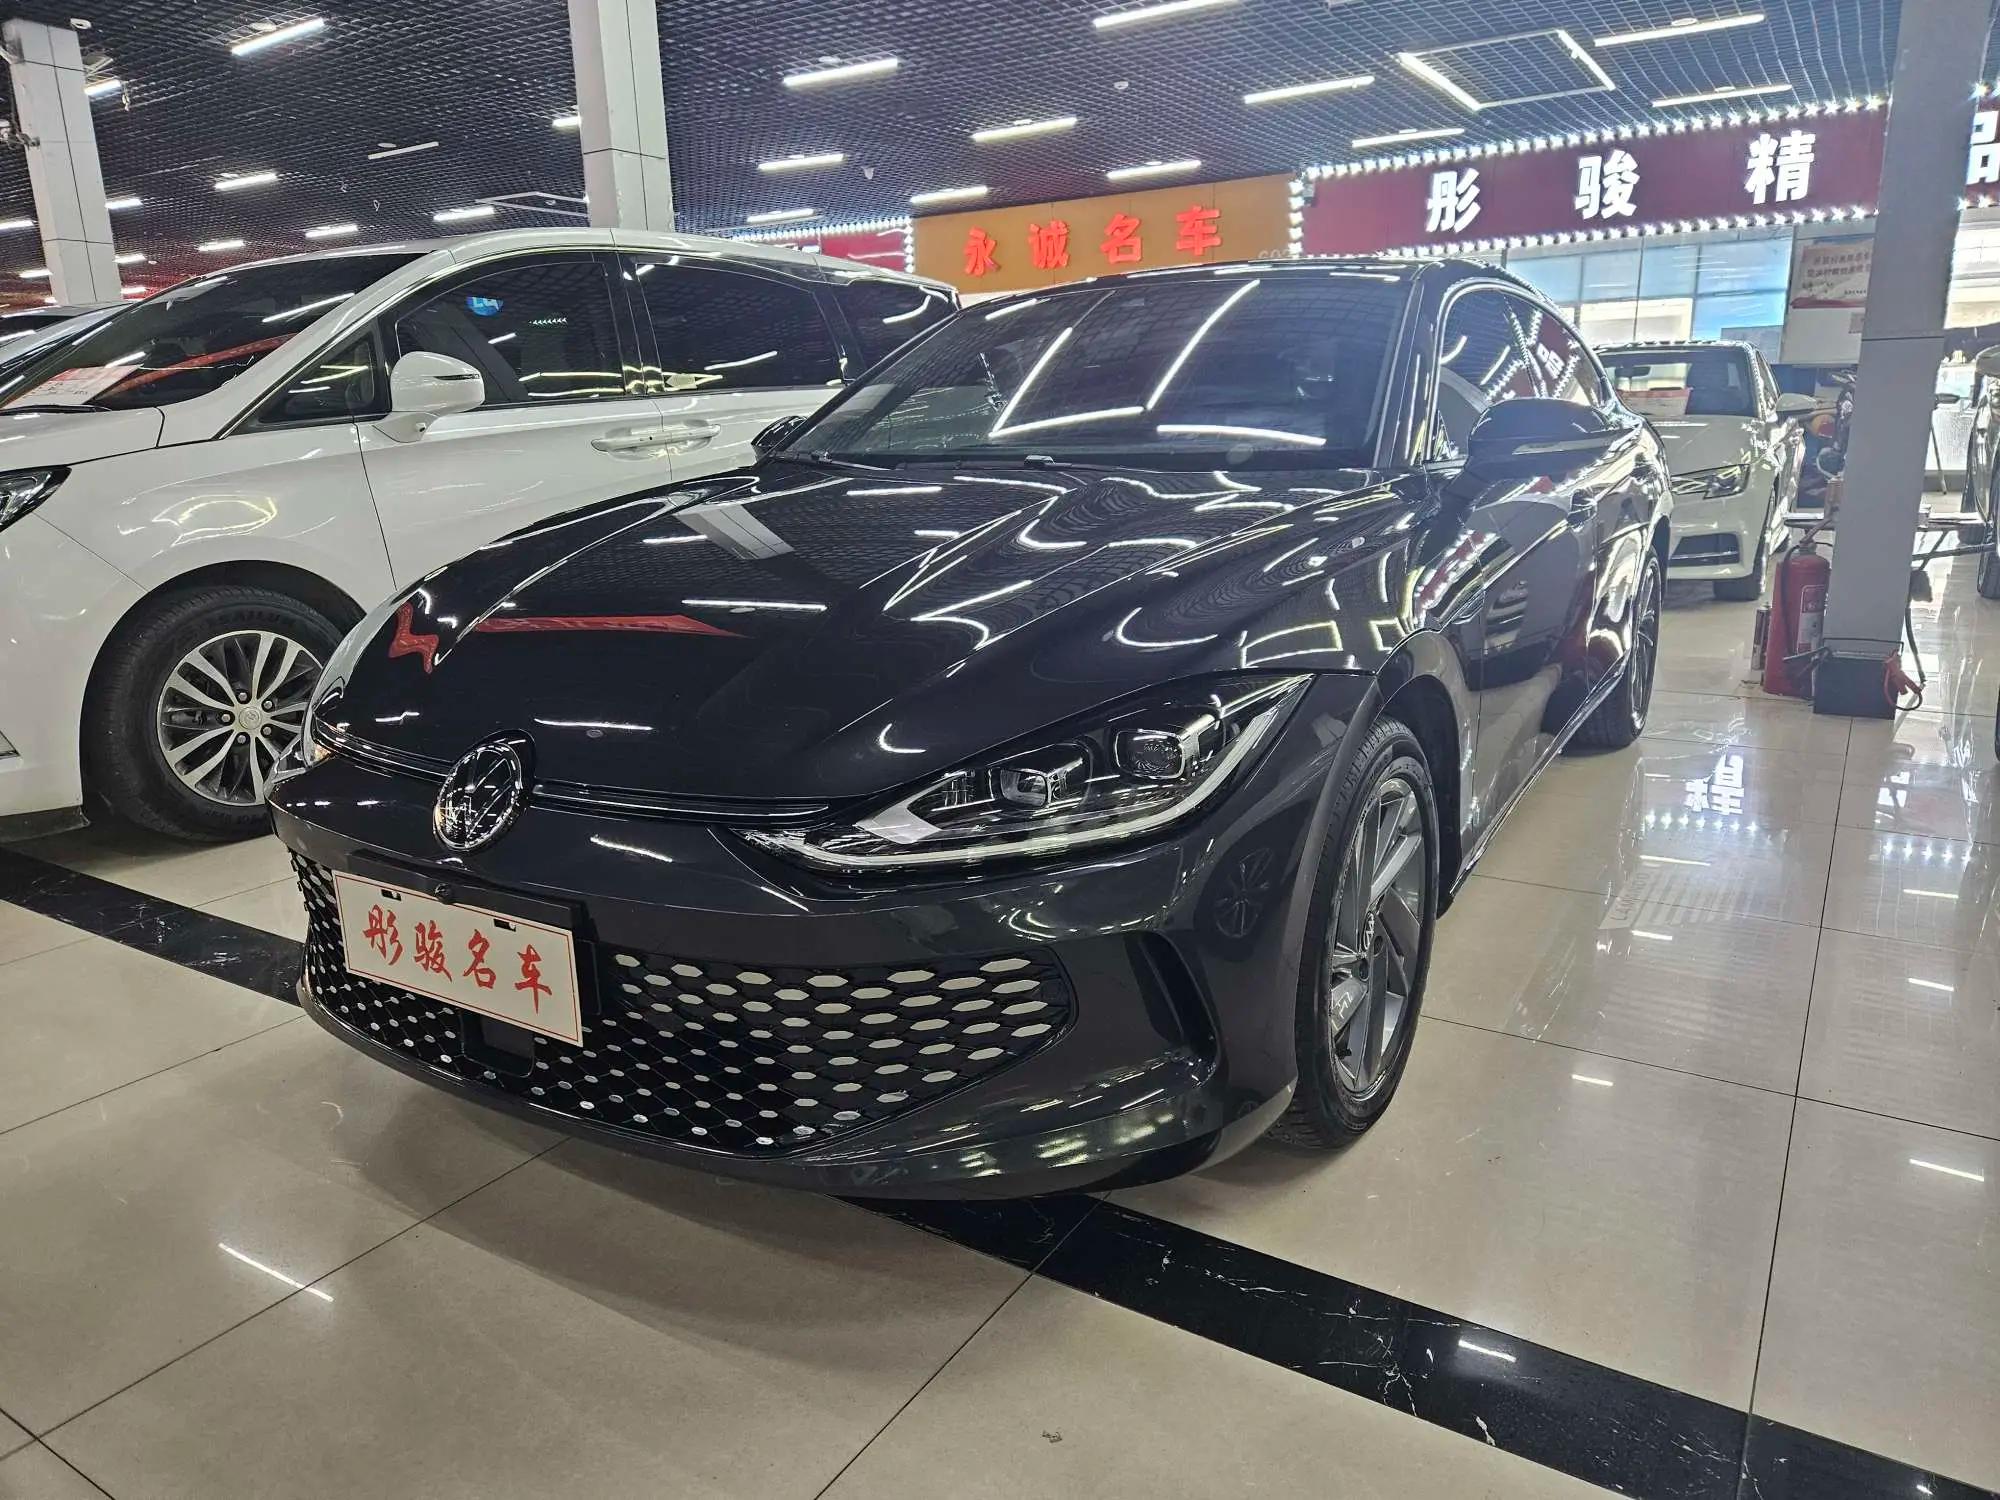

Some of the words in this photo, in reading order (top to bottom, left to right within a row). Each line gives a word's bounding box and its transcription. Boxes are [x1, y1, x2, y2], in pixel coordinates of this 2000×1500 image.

[963, 205, 1222, 277] 永诚名车
[362, 904, 552, 1015] 彤骏名车
